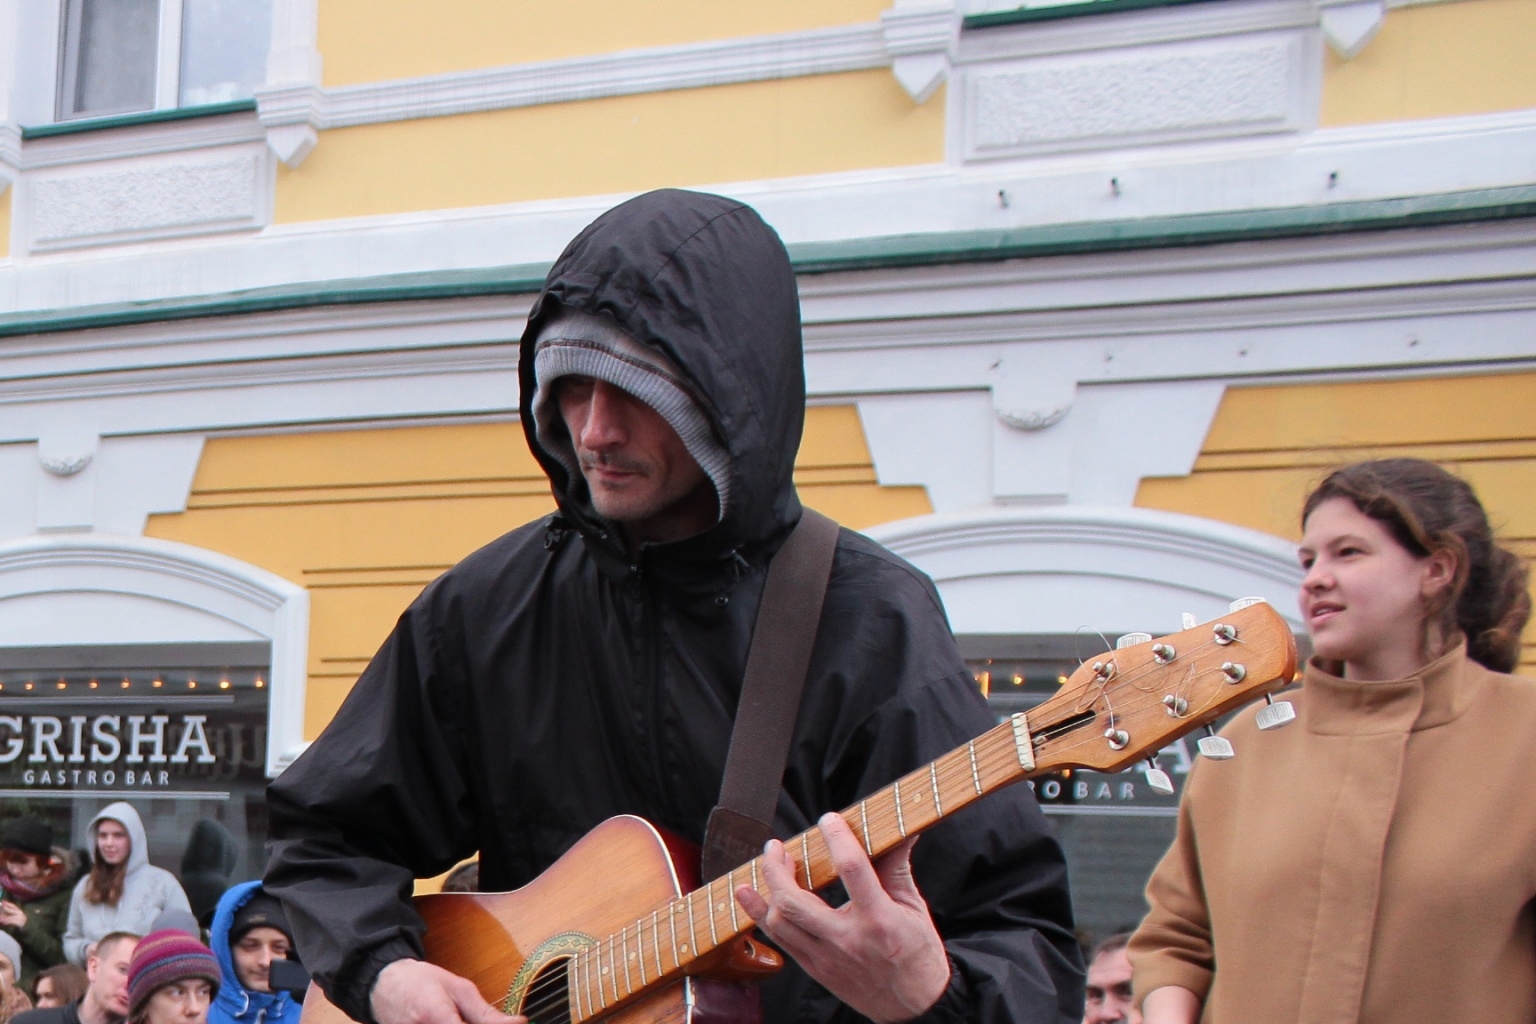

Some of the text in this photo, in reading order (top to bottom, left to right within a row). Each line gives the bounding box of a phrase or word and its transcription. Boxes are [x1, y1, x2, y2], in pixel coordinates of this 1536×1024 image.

[23, 769, 170, 787] GASTRO BAR
[1073, 780, 1135, 800] BAR
